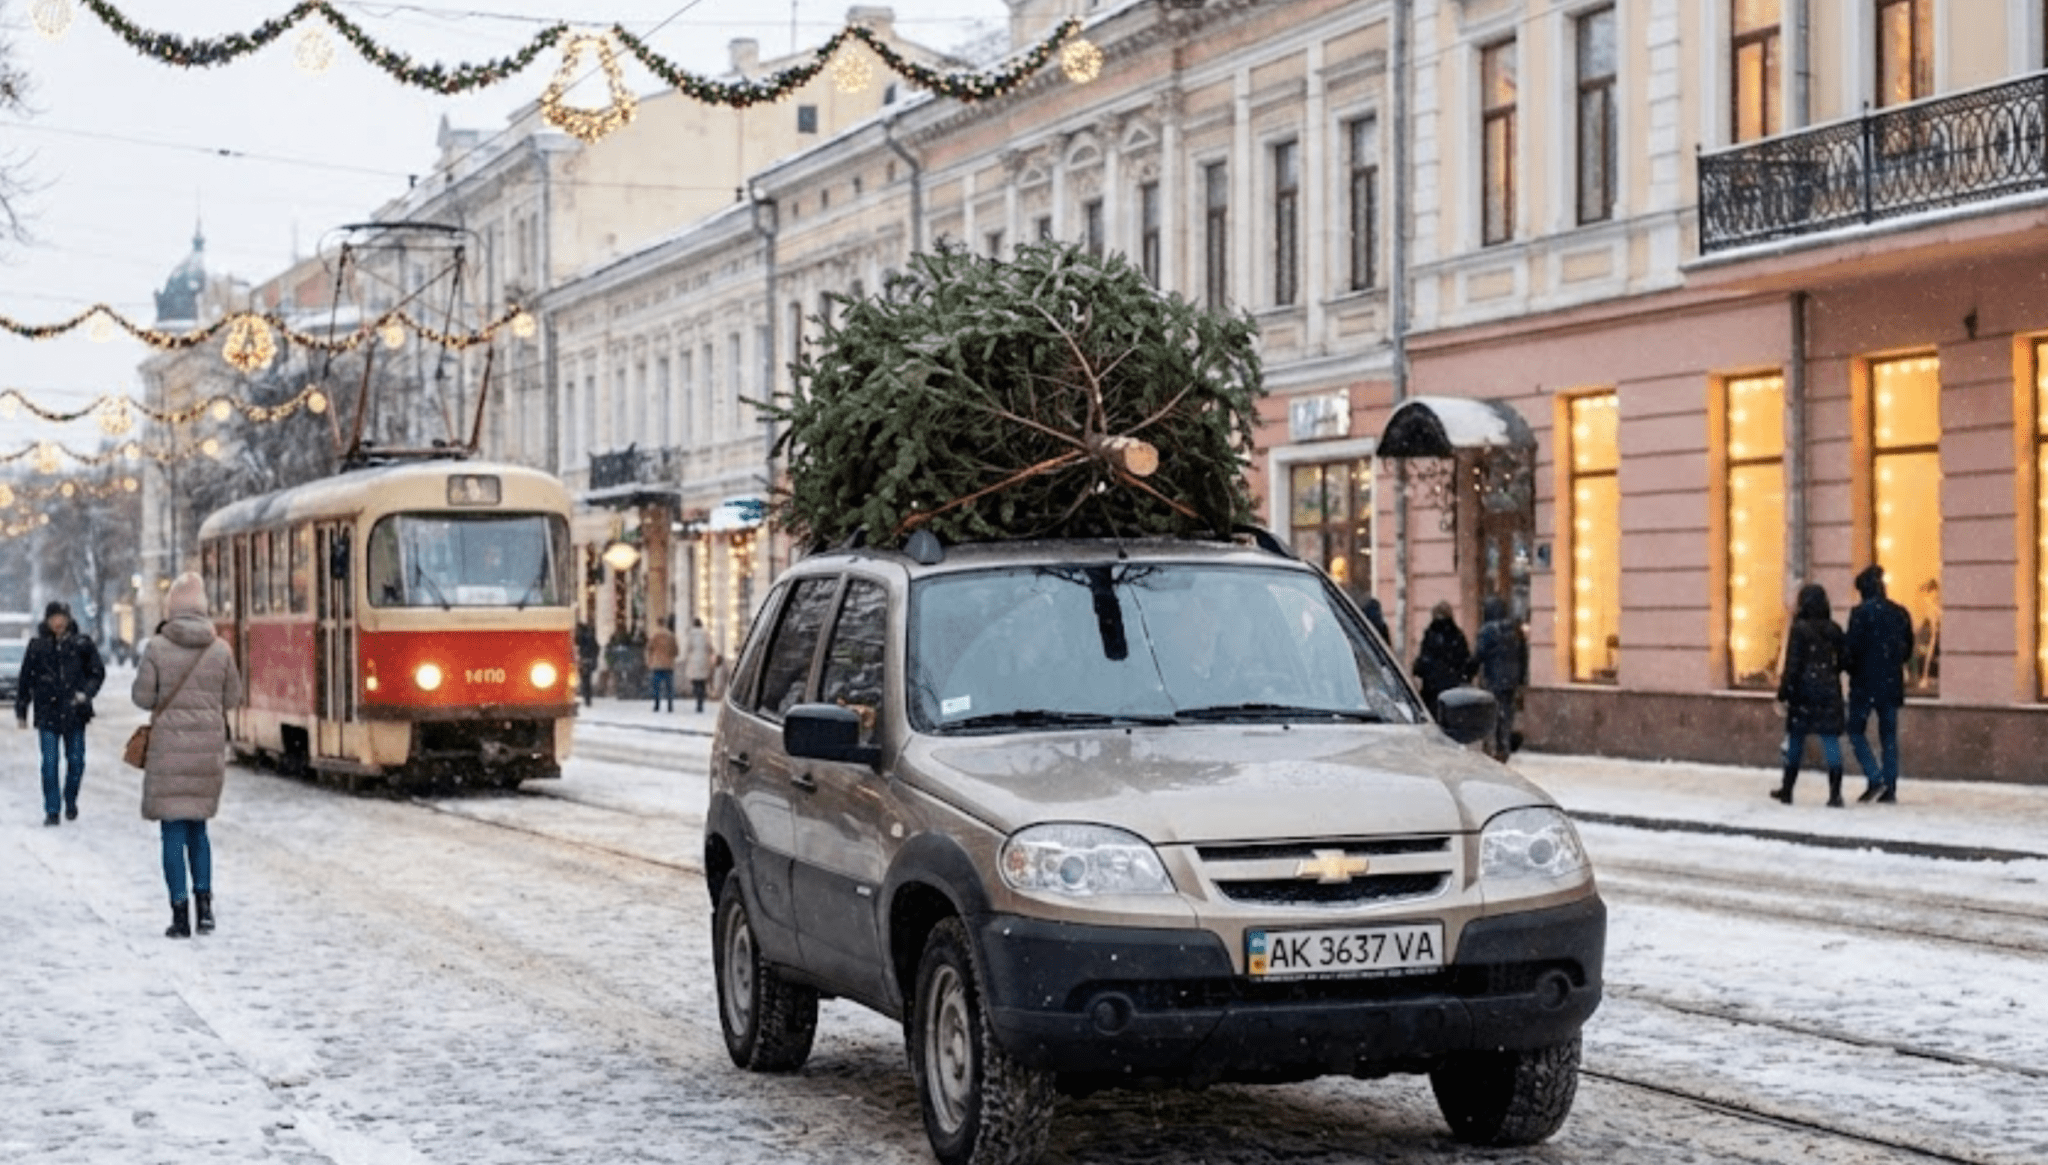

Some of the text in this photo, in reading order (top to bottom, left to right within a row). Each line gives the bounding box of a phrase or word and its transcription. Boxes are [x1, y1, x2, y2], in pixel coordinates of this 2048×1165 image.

[1270, 931, 1435, 968] AK 3637 VA
